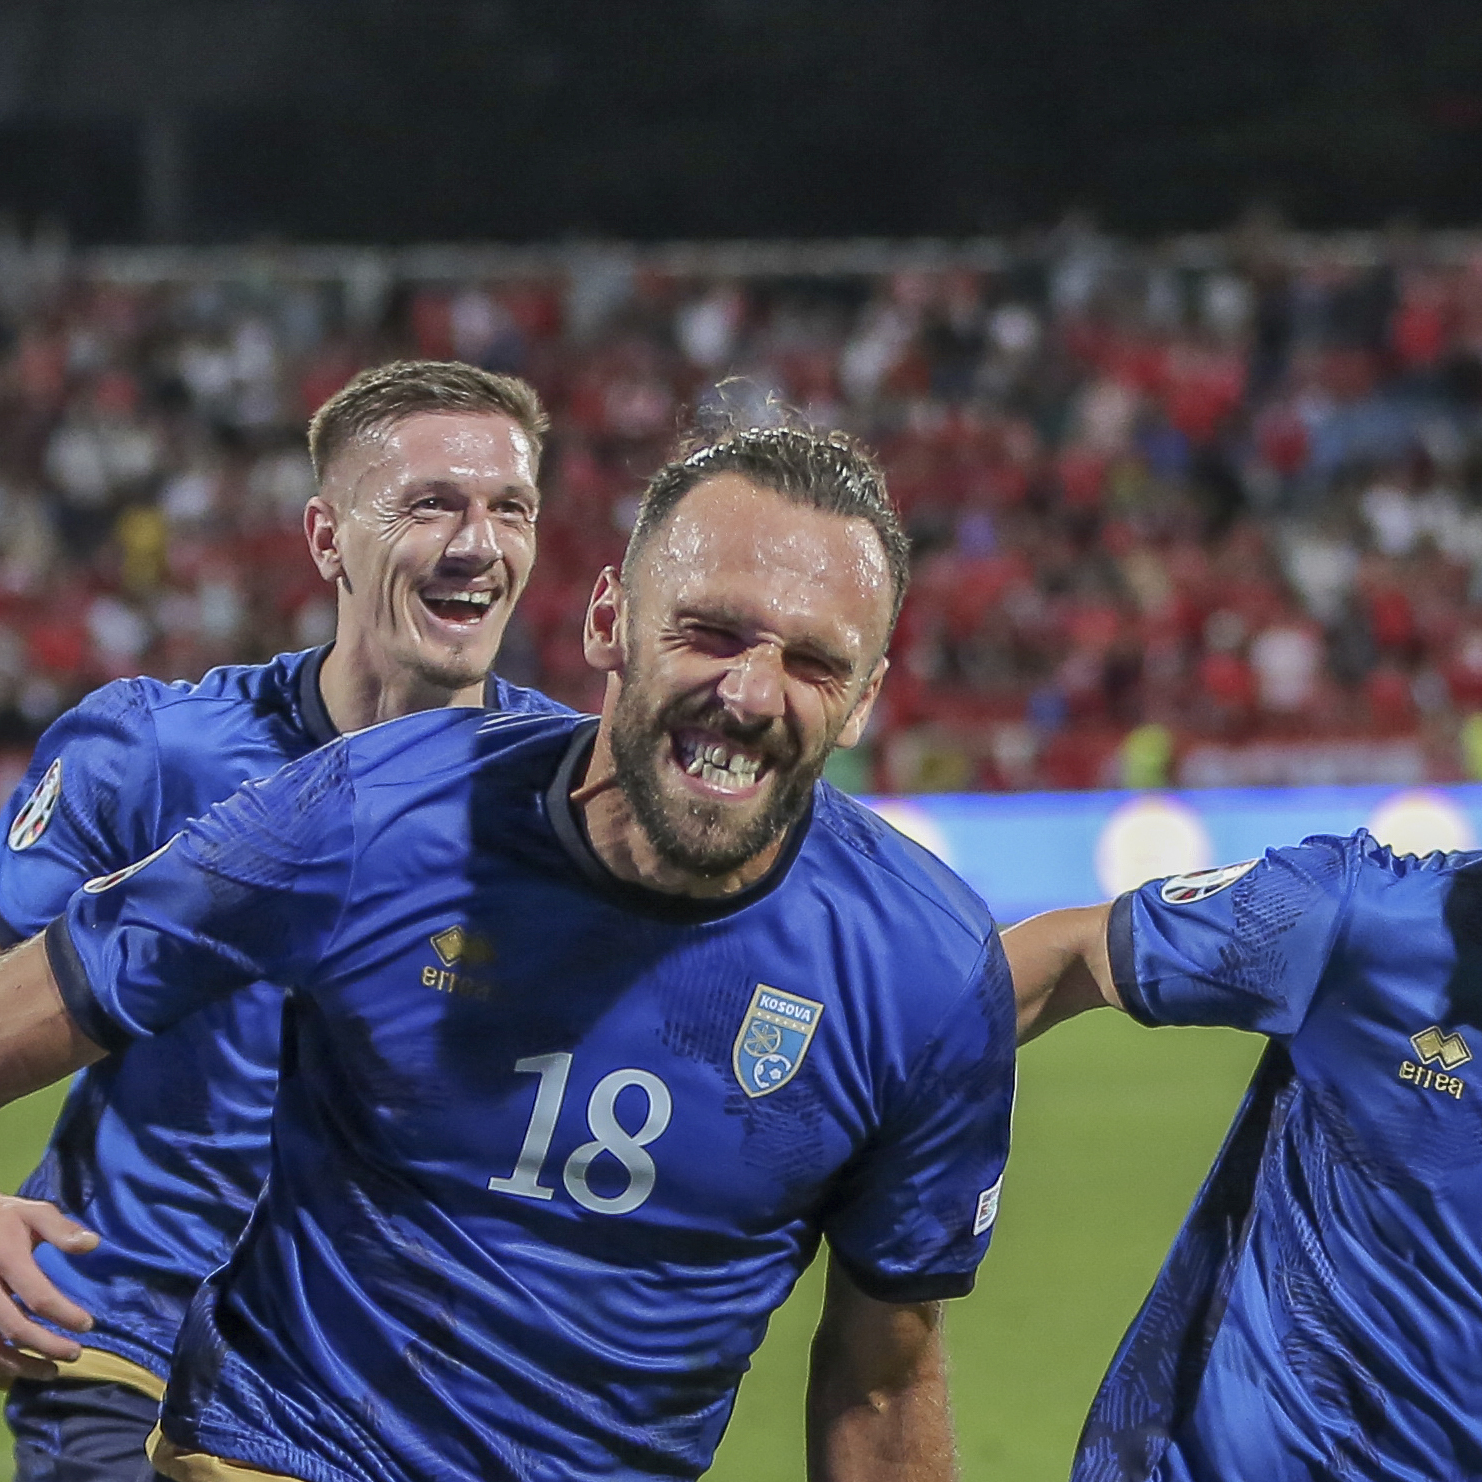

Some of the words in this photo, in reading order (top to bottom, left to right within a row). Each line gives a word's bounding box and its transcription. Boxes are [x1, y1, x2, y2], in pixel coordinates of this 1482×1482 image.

[759, 994, 812, 1022] KOSOVA
[1399, 1060, 1464, 1099] errea
[488, 1052, 673, 1215] 18
